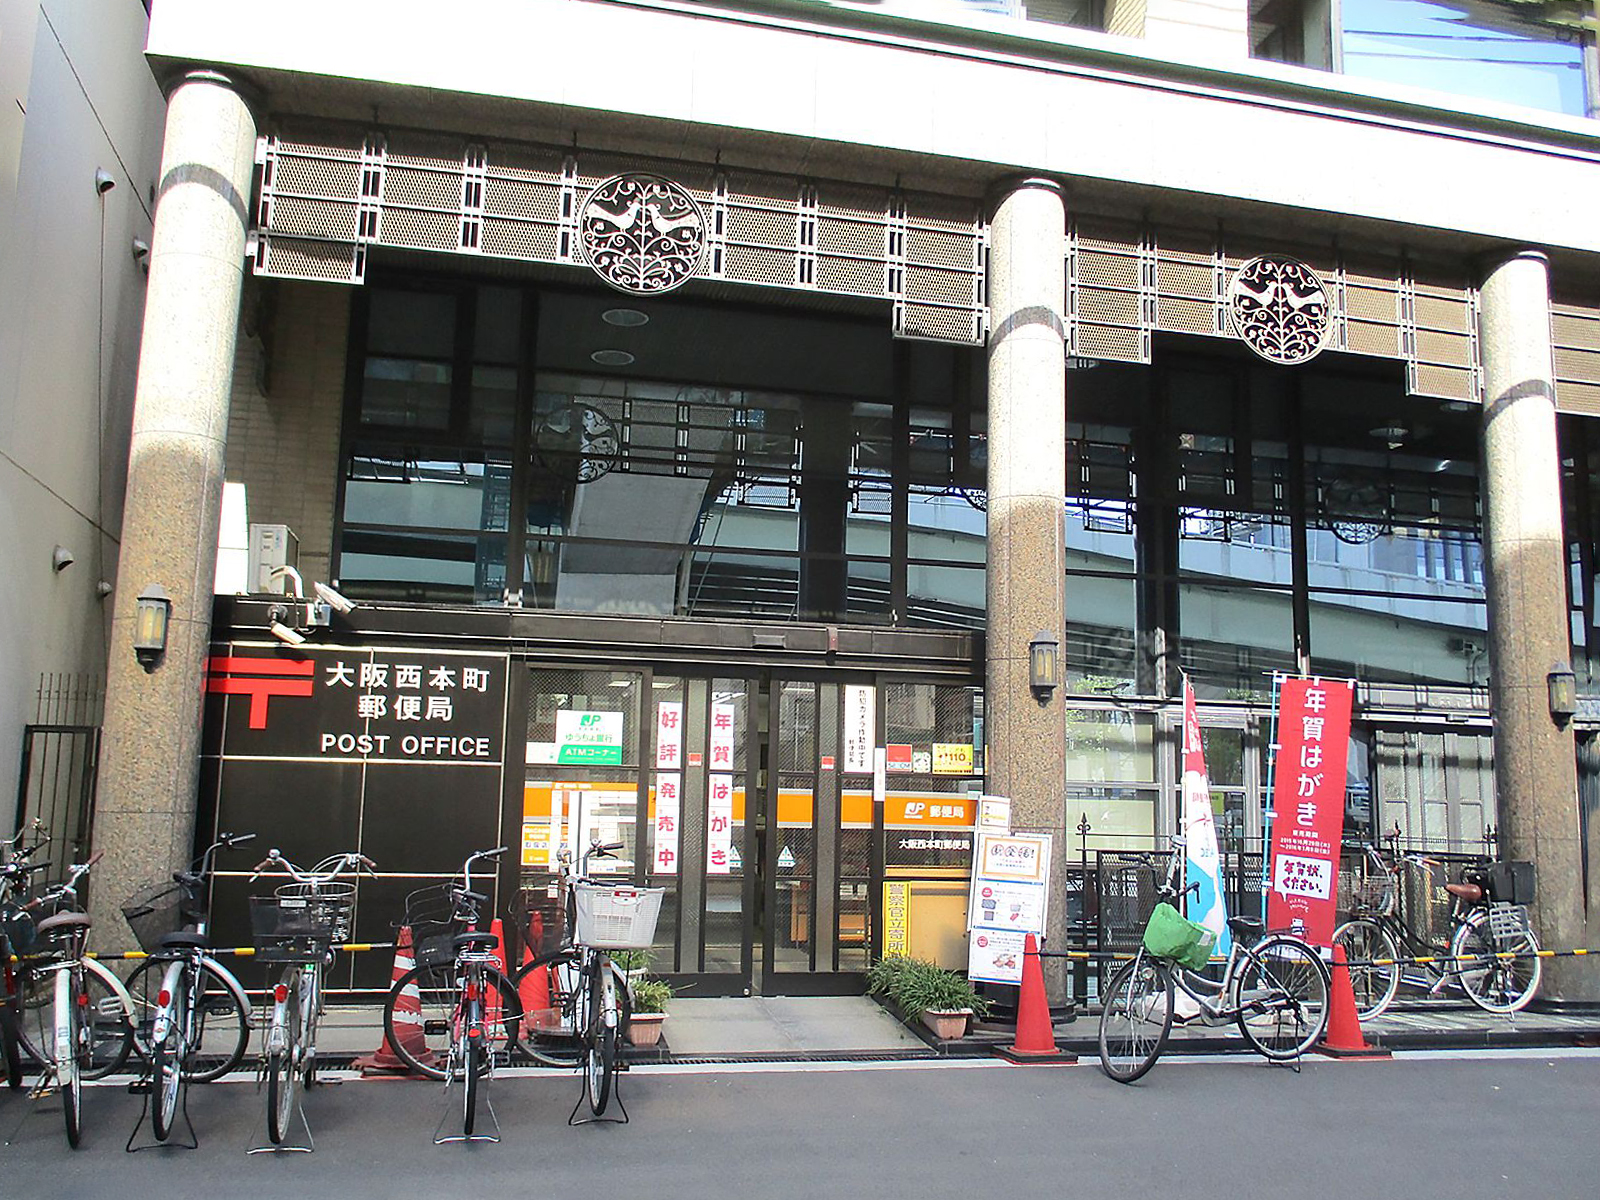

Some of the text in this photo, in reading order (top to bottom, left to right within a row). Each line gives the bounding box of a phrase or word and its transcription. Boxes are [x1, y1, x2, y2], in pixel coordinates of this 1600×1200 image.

[326, 661, 490, 692] 大阪西本町
[358, 695, 453, 721] 郵便局
[580, 715, 601, 726] JP
[321, 734, 490, 756] POST OFFICE
[1296, 688, 1327, 827] 年賀はがき
[658, 711, 679, 866] 好評発売中
[711, 713, 732, 865] 年賀はがき
[930, 805, 964, 818] 郵便局
[899, 838, 970, 849] 大阪西本町郵便局
